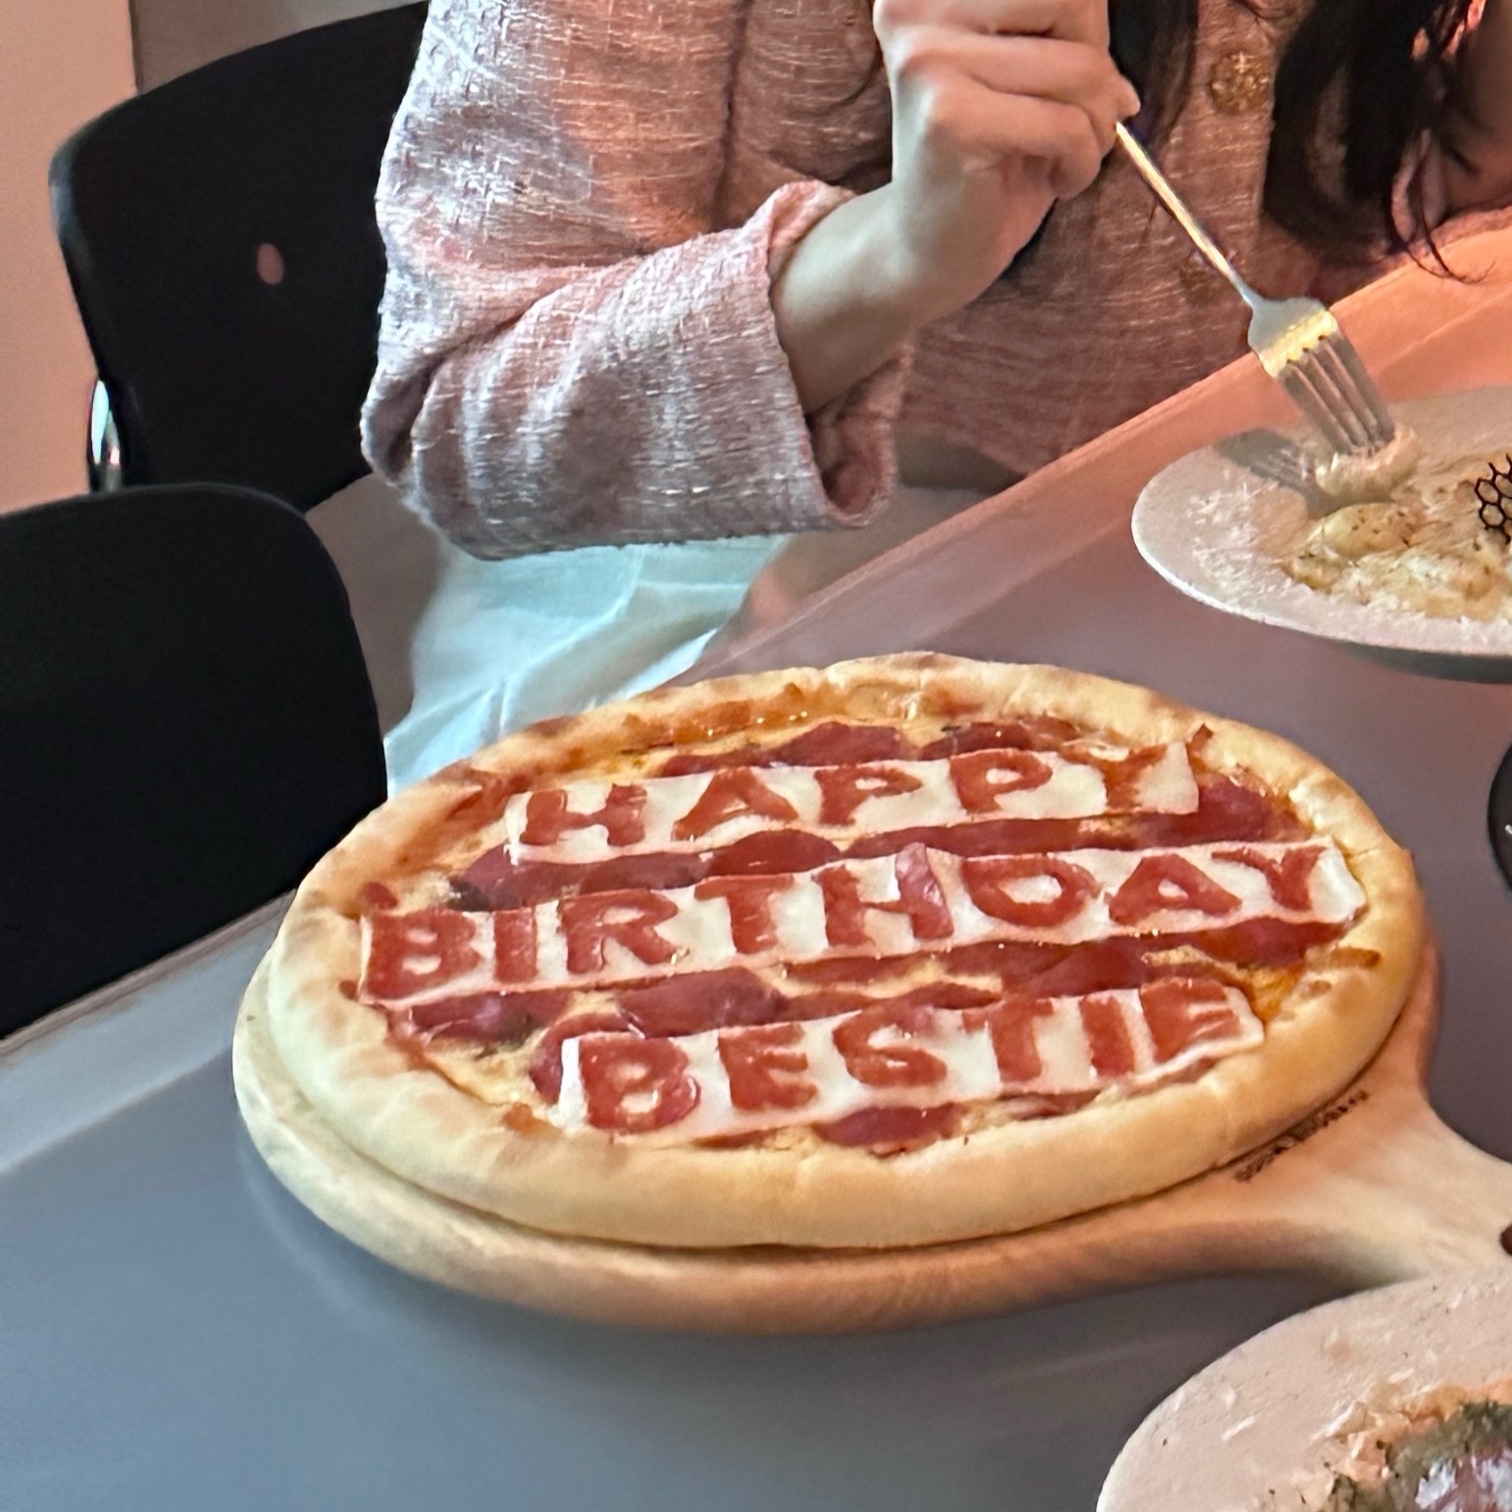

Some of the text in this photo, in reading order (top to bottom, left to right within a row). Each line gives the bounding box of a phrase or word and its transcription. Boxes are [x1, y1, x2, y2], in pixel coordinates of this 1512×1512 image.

[518, 744, 1170, 845] HAPPY
[368, 842, 1326, 1002] BIRTHDAY
[577, 978, 1240, 1132] BESTIE
